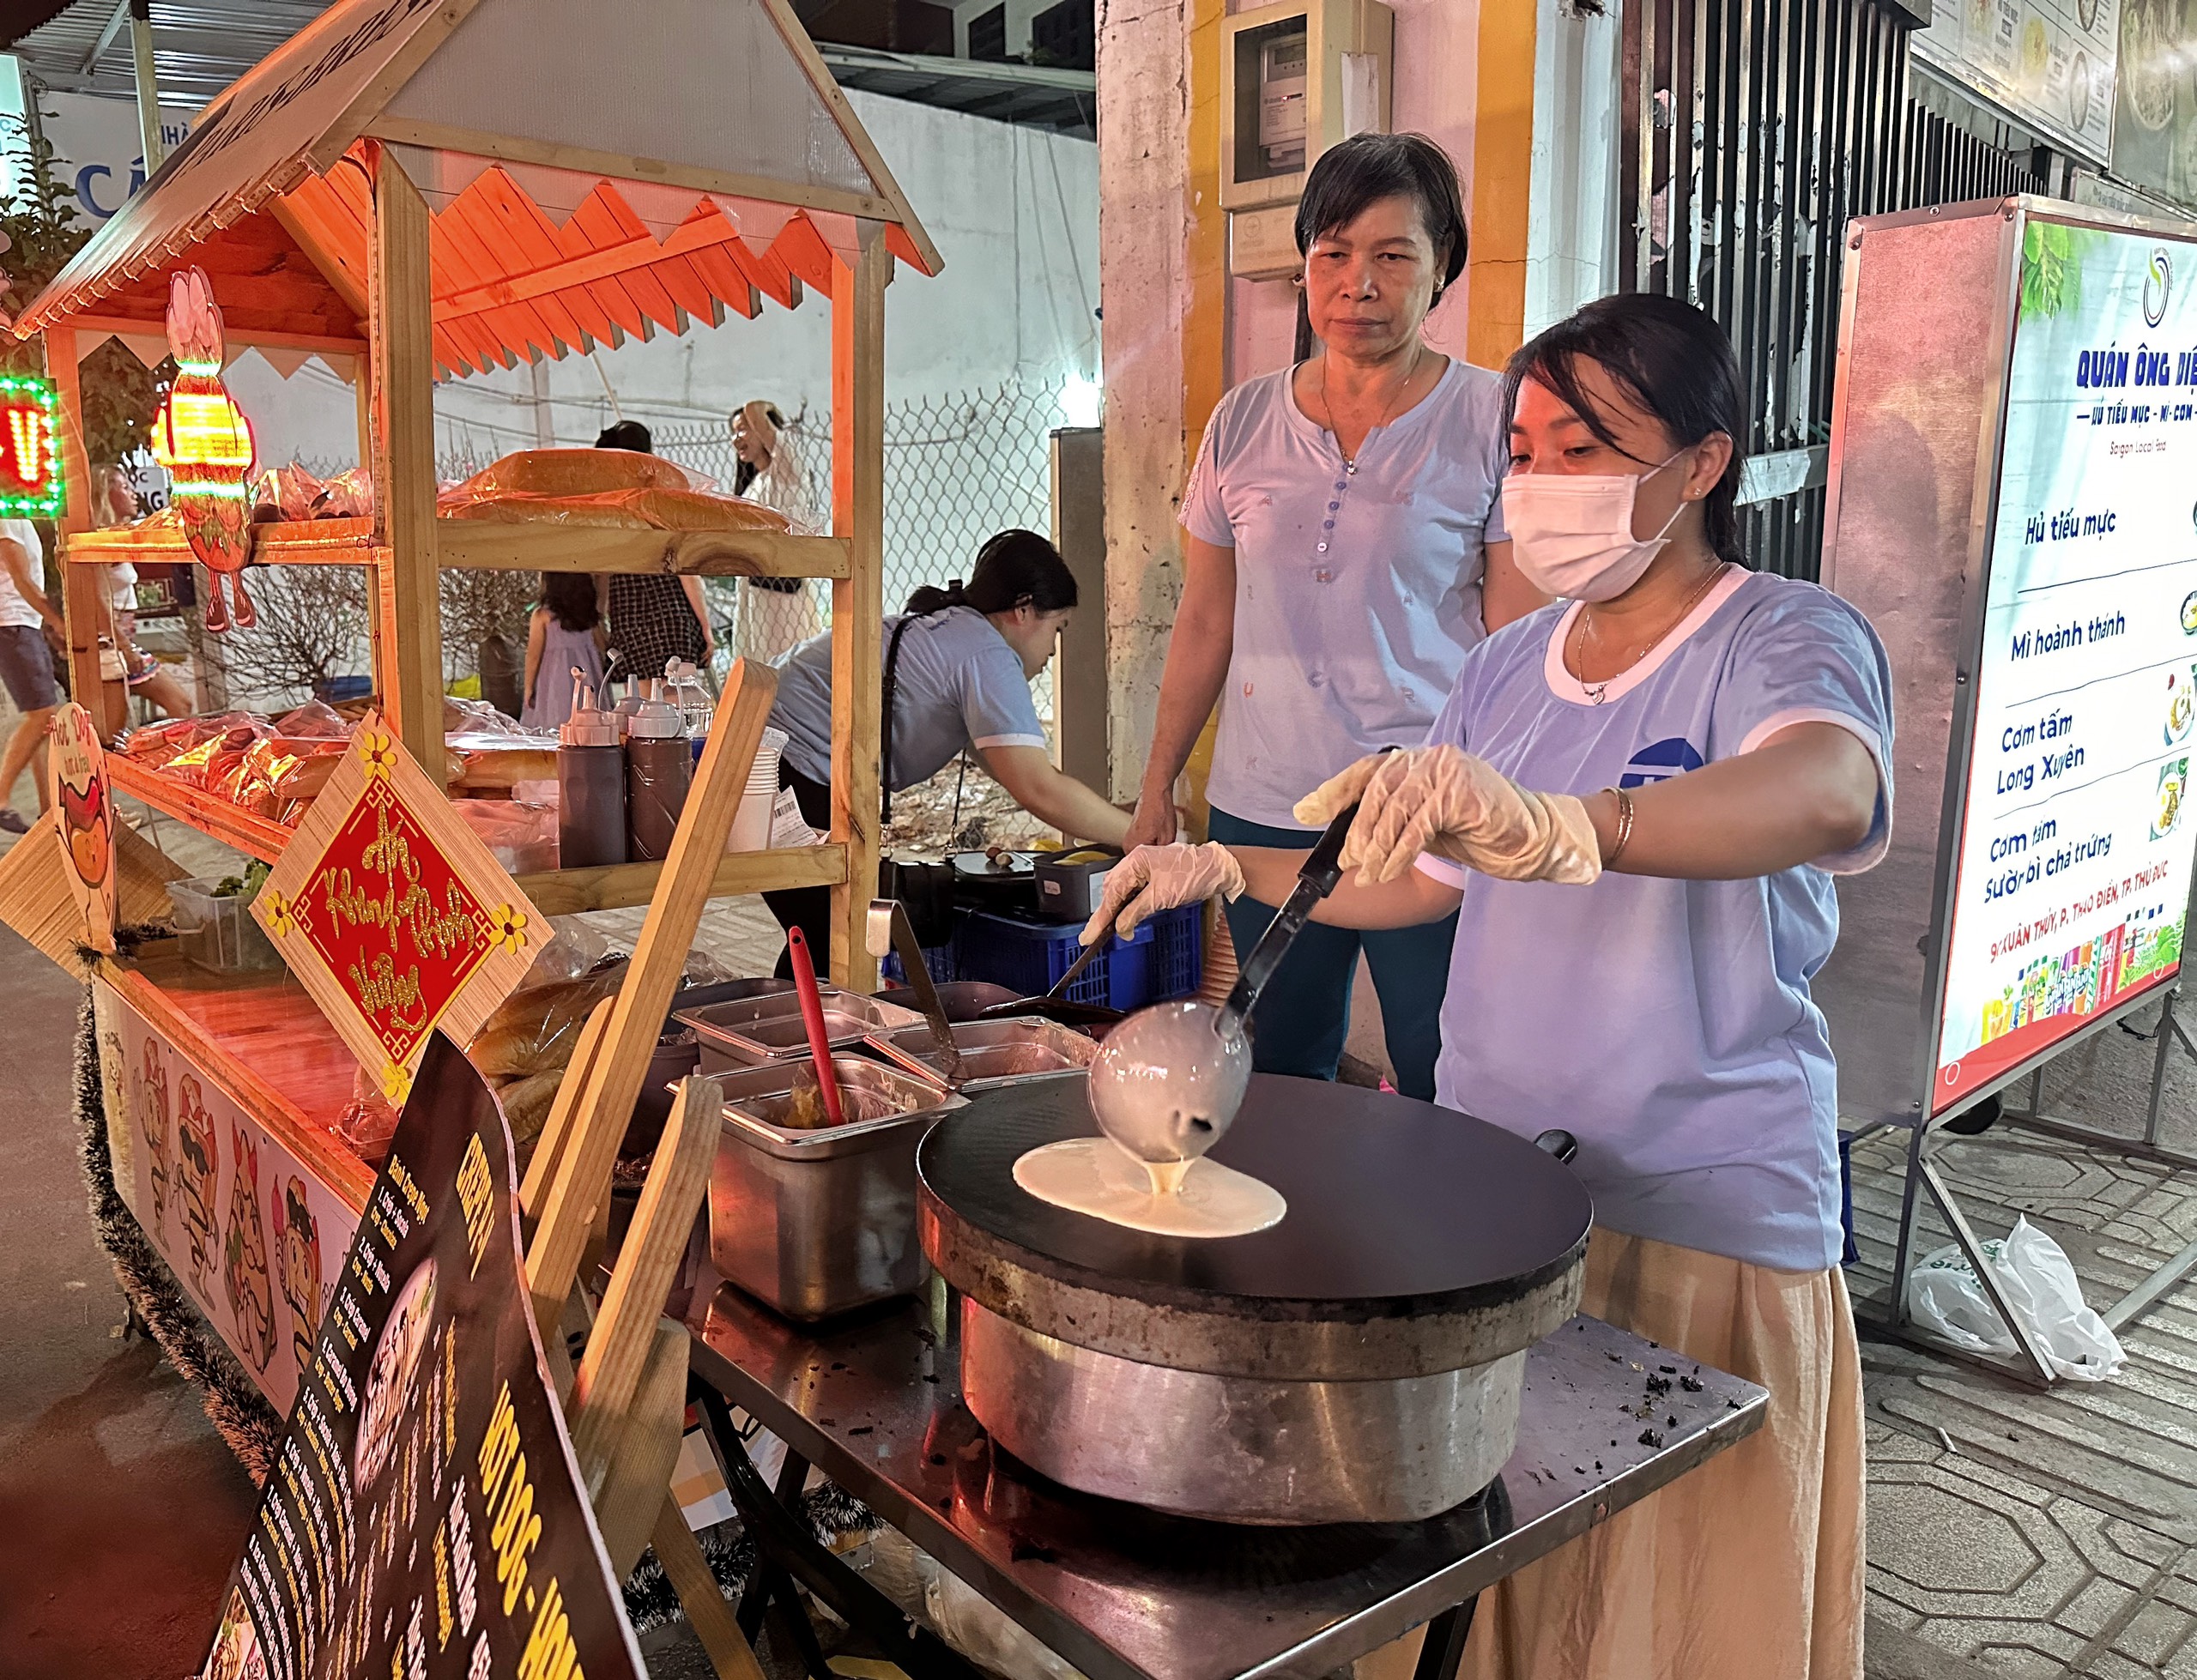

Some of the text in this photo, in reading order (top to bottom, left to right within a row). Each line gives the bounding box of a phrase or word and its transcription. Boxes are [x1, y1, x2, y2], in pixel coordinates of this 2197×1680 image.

[2077, 341, 2129, 389] QUÁN
[2134, 342, 2170, 386] ÔNG
[2107, 399, 2127, 425] TIẾU
[2025, 507, 2116, 545] Hủ tiếu mực
[2011, 610, 2125, 662] Mì hoành thánh
[2001, 708, 2073, 752] Cơm tấm
[1996, 743, 2085, 795] Long Xuyên
[1990, 833, 2027, 863] Cơm
[2026, 856, 2040, 885] bì
[2046, 842, 2072, 876] chả
[2074, 832, 2112, 863] trứng
[324, 866, 401, 953] Khang
[2060, 908, 2068, 928] P.
[2121, 878, 2132, 898] TP.
[402, 1172, 419, 1206] Crepe
[353, 1307, 371, 1343] Caramel
[325, 1343, 344, 1379] Caramel
[478, 1379, 520, 1517] HOT
[491, 1452, 542, 1617] DOG
